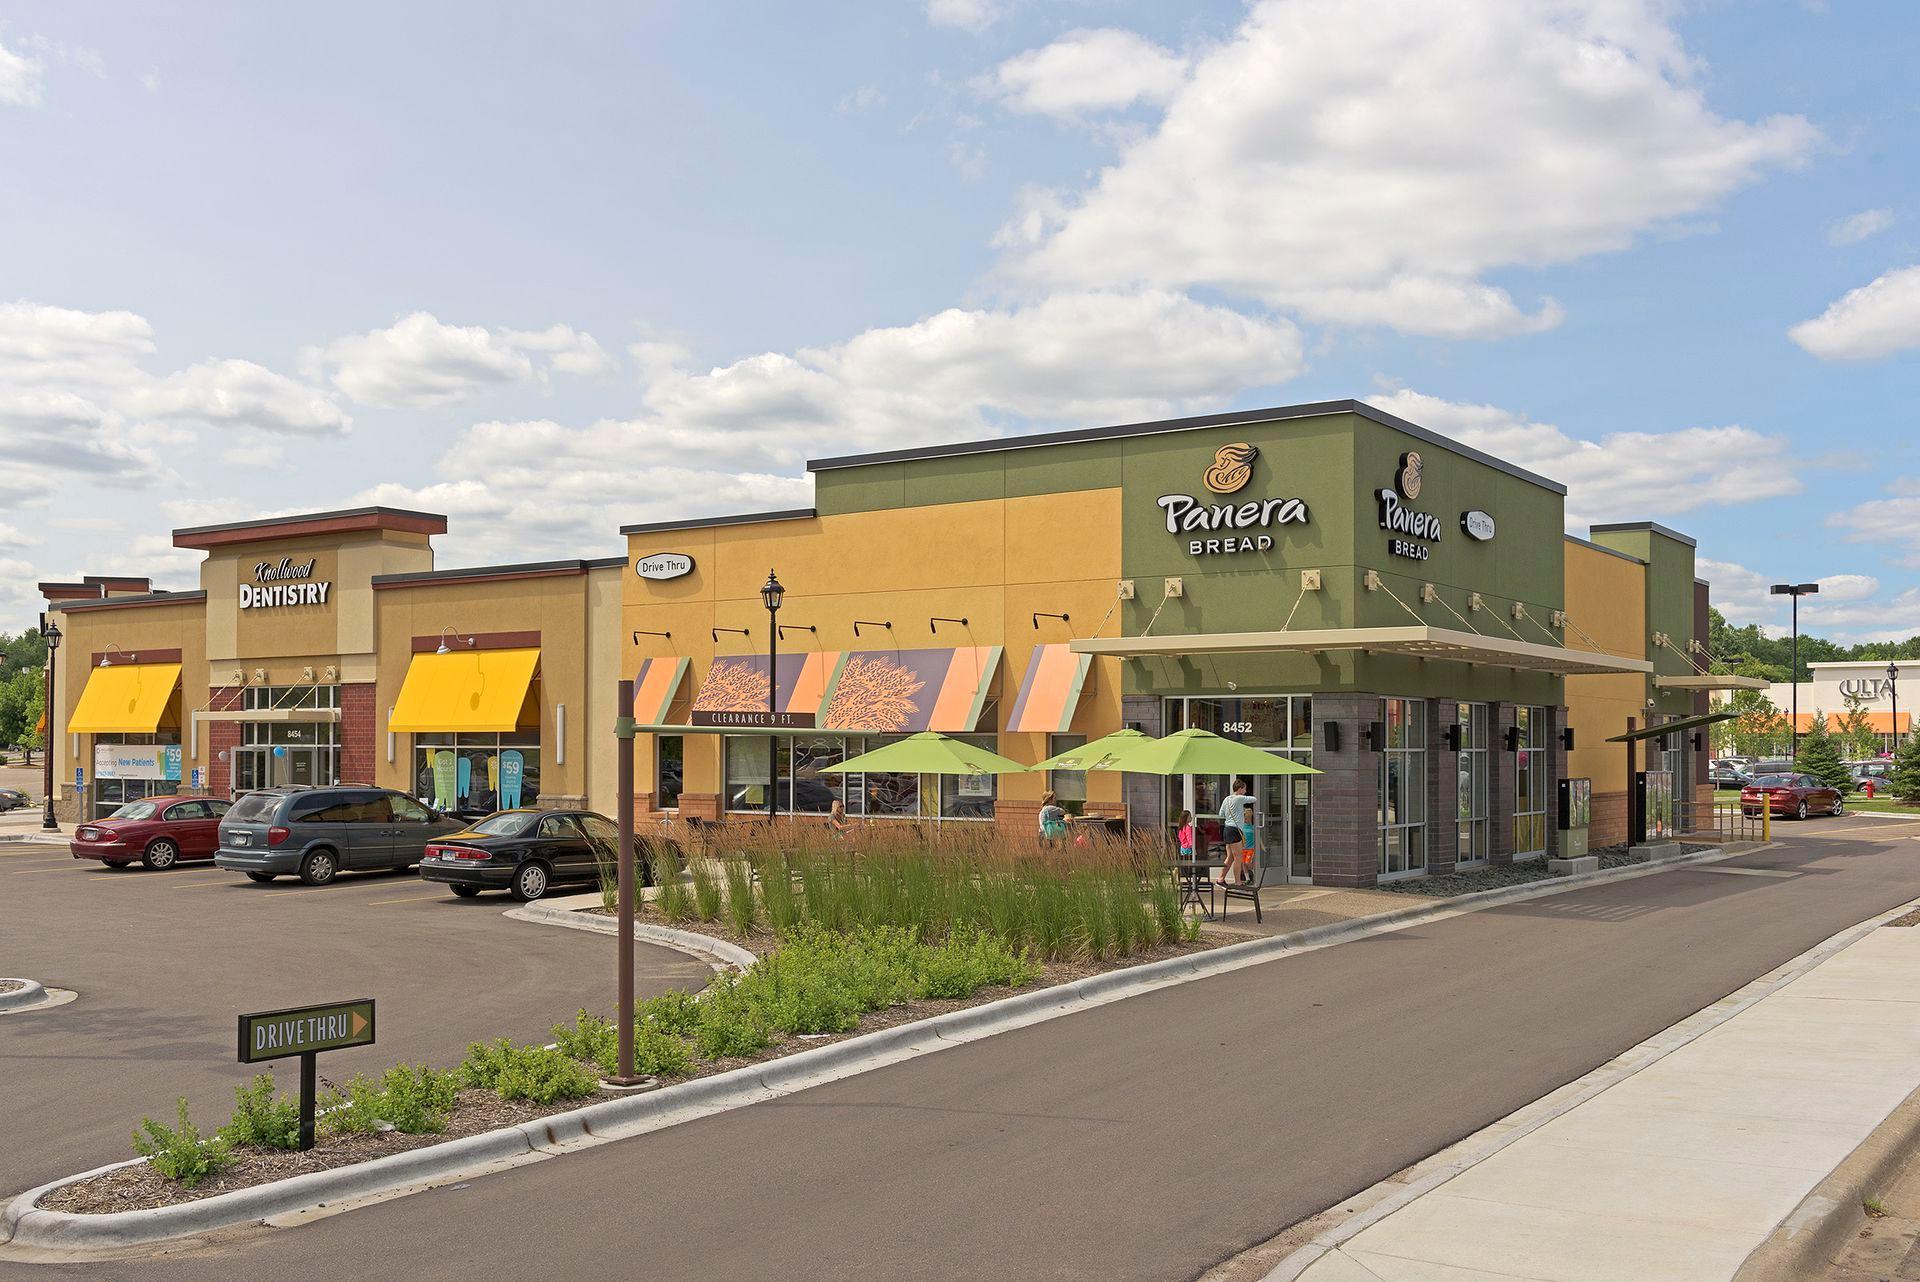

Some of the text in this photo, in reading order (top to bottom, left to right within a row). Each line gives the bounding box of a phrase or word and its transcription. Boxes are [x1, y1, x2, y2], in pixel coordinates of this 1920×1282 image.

[1157, 494, 1307, 534] Panera
[1382, 488, 1441, 542] Panera
[1470, 517, 1492, 533] Drive Thru
[1189, 535, 1273, 555] BREAD
[1395, 539, 1429, 561] BREAD
[254, 558, 315, 583] Knollwood
[642, 560, 686, 573] Drive Thru
[239, 582, 329, 609] DENTISTRY
[1846, 678, 1894, 694] ULTA
[711, 713, 794, 725] CLEARANCE 9 FT.
[287, 730, 301, 738] 8454
[1223, 722, 1252, 733] 8452
[96, 758, 155, 767] Accepting New Patients
[166, 748, 182, 762] $59
[502, 761, 520, 775] $59
[256, 1013, 347, 1050] DRIVE THRU
